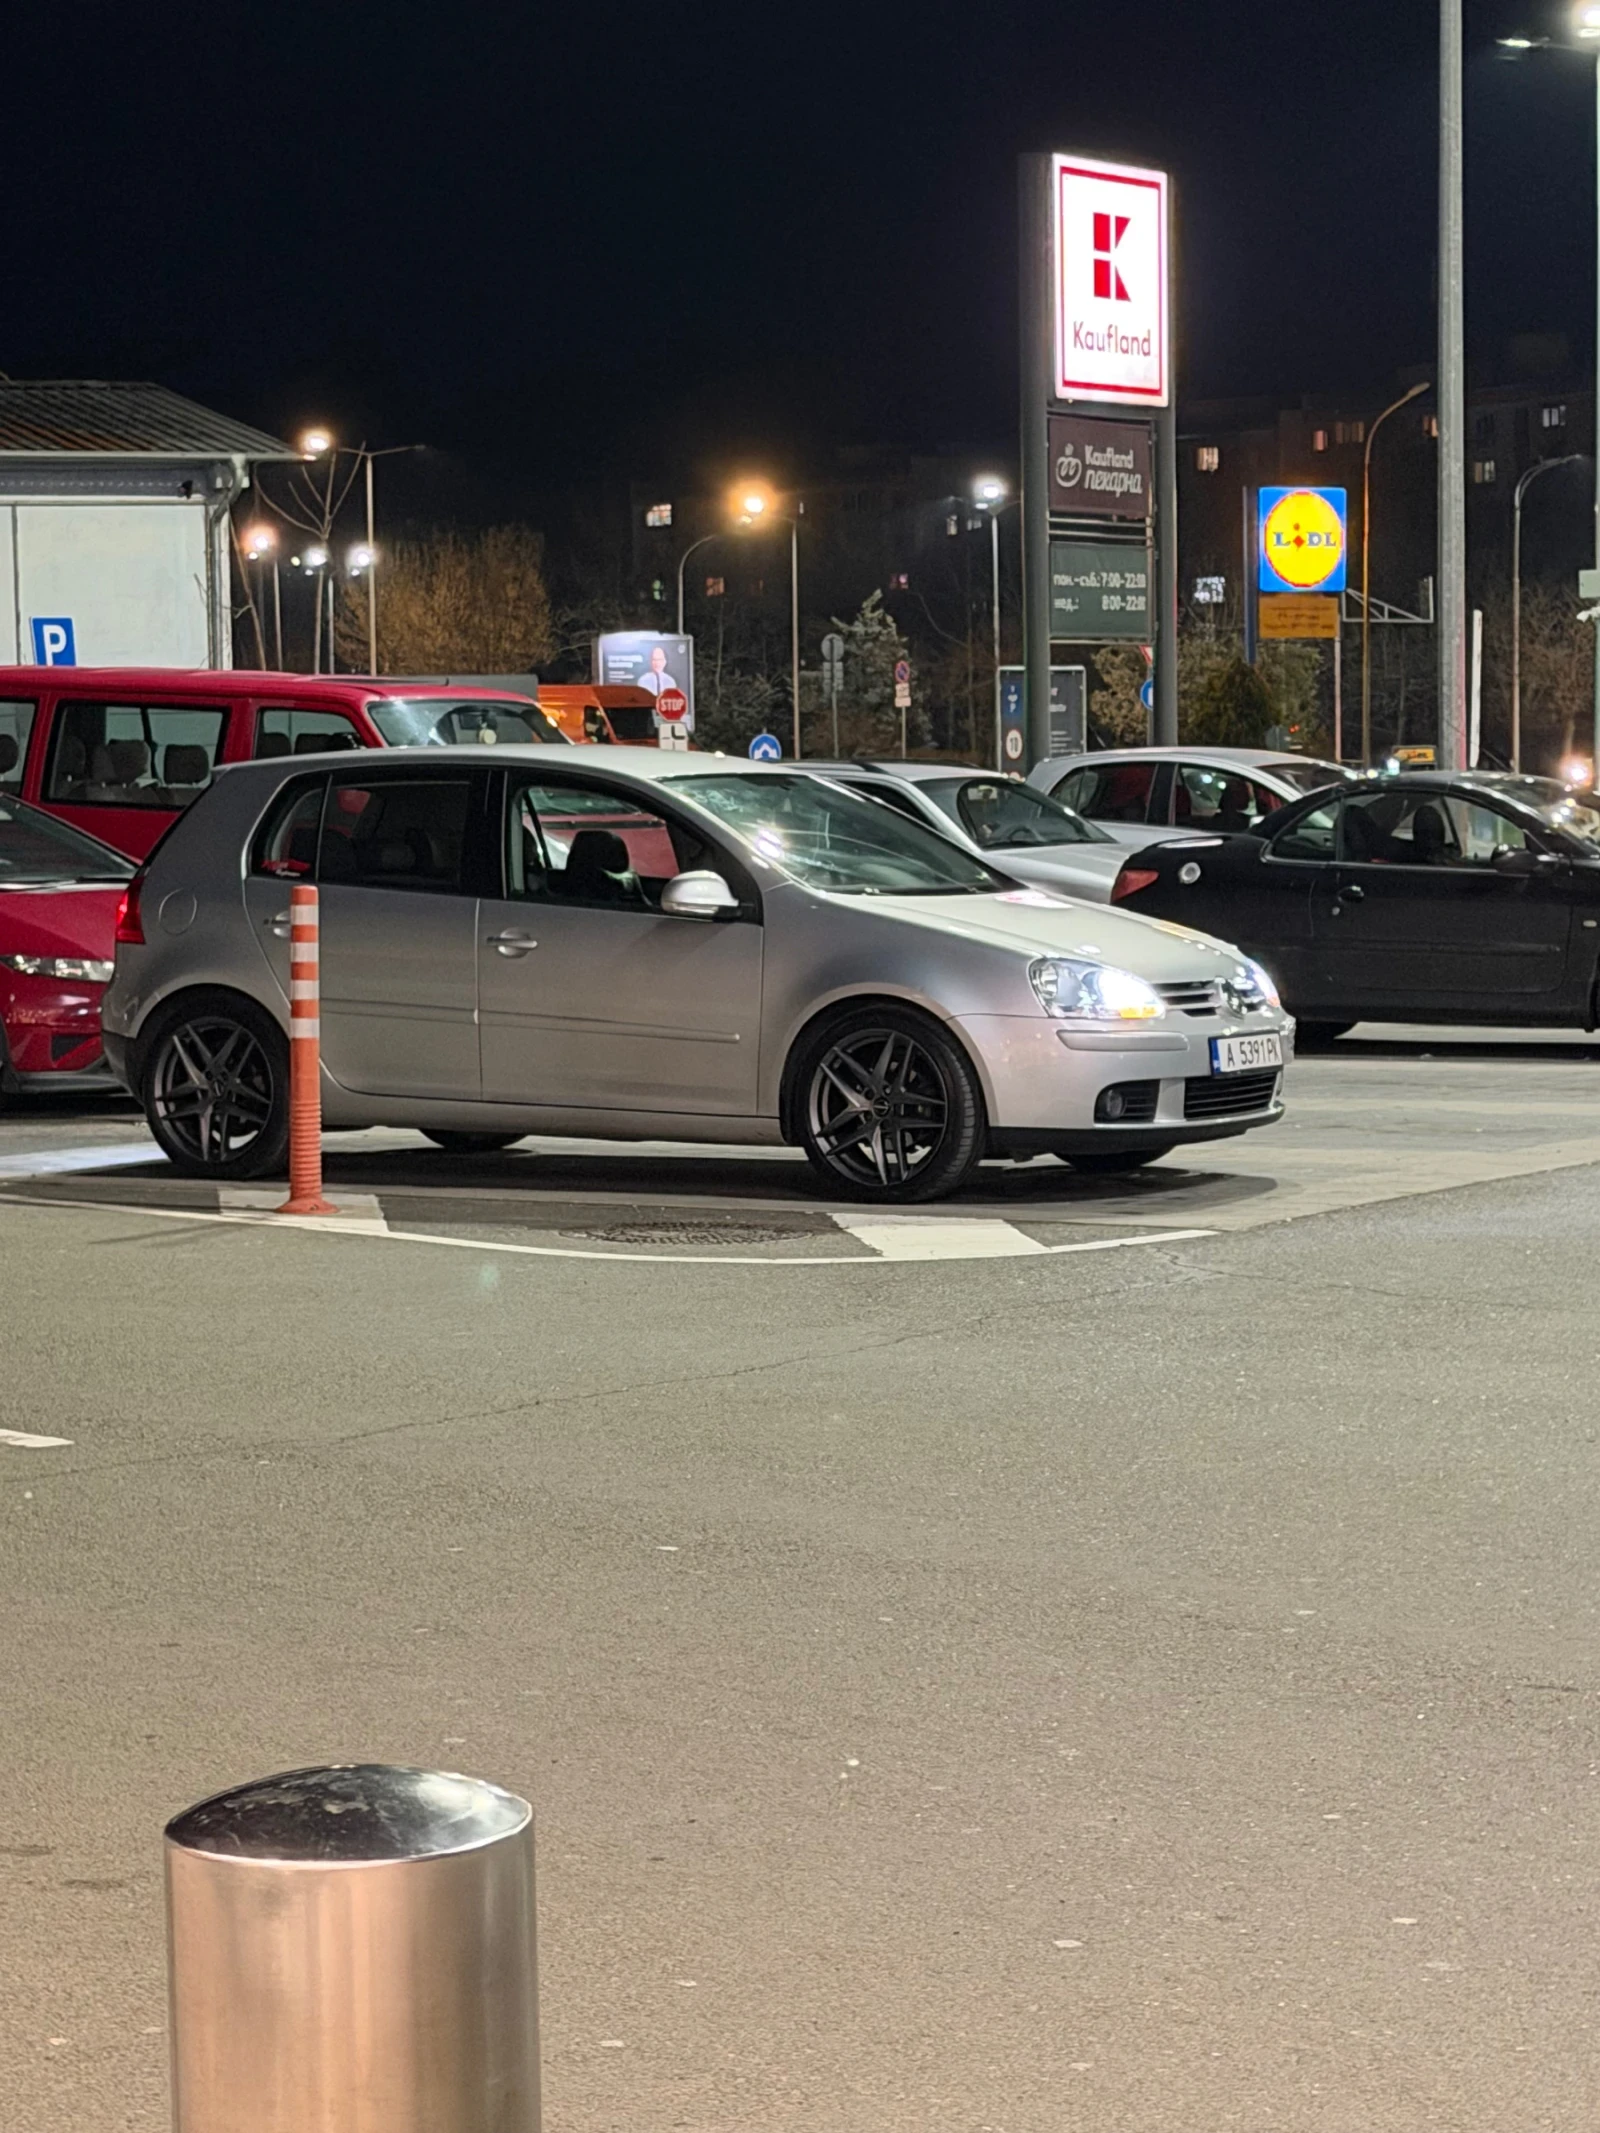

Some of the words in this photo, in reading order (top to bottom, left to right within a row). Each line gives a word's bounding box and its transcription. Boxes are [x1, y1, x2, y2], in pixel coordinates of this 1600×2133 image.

[1073, 320, 1151, 357] Kaufland
[1085, 444, 1134, 470] Kaufland
[1272, 522, 1337, 552] LIDL
[42, 624, 67, 666] P
[660, 698, 685, 712] STOP
[1227, 1042, 1236, 1068] A
